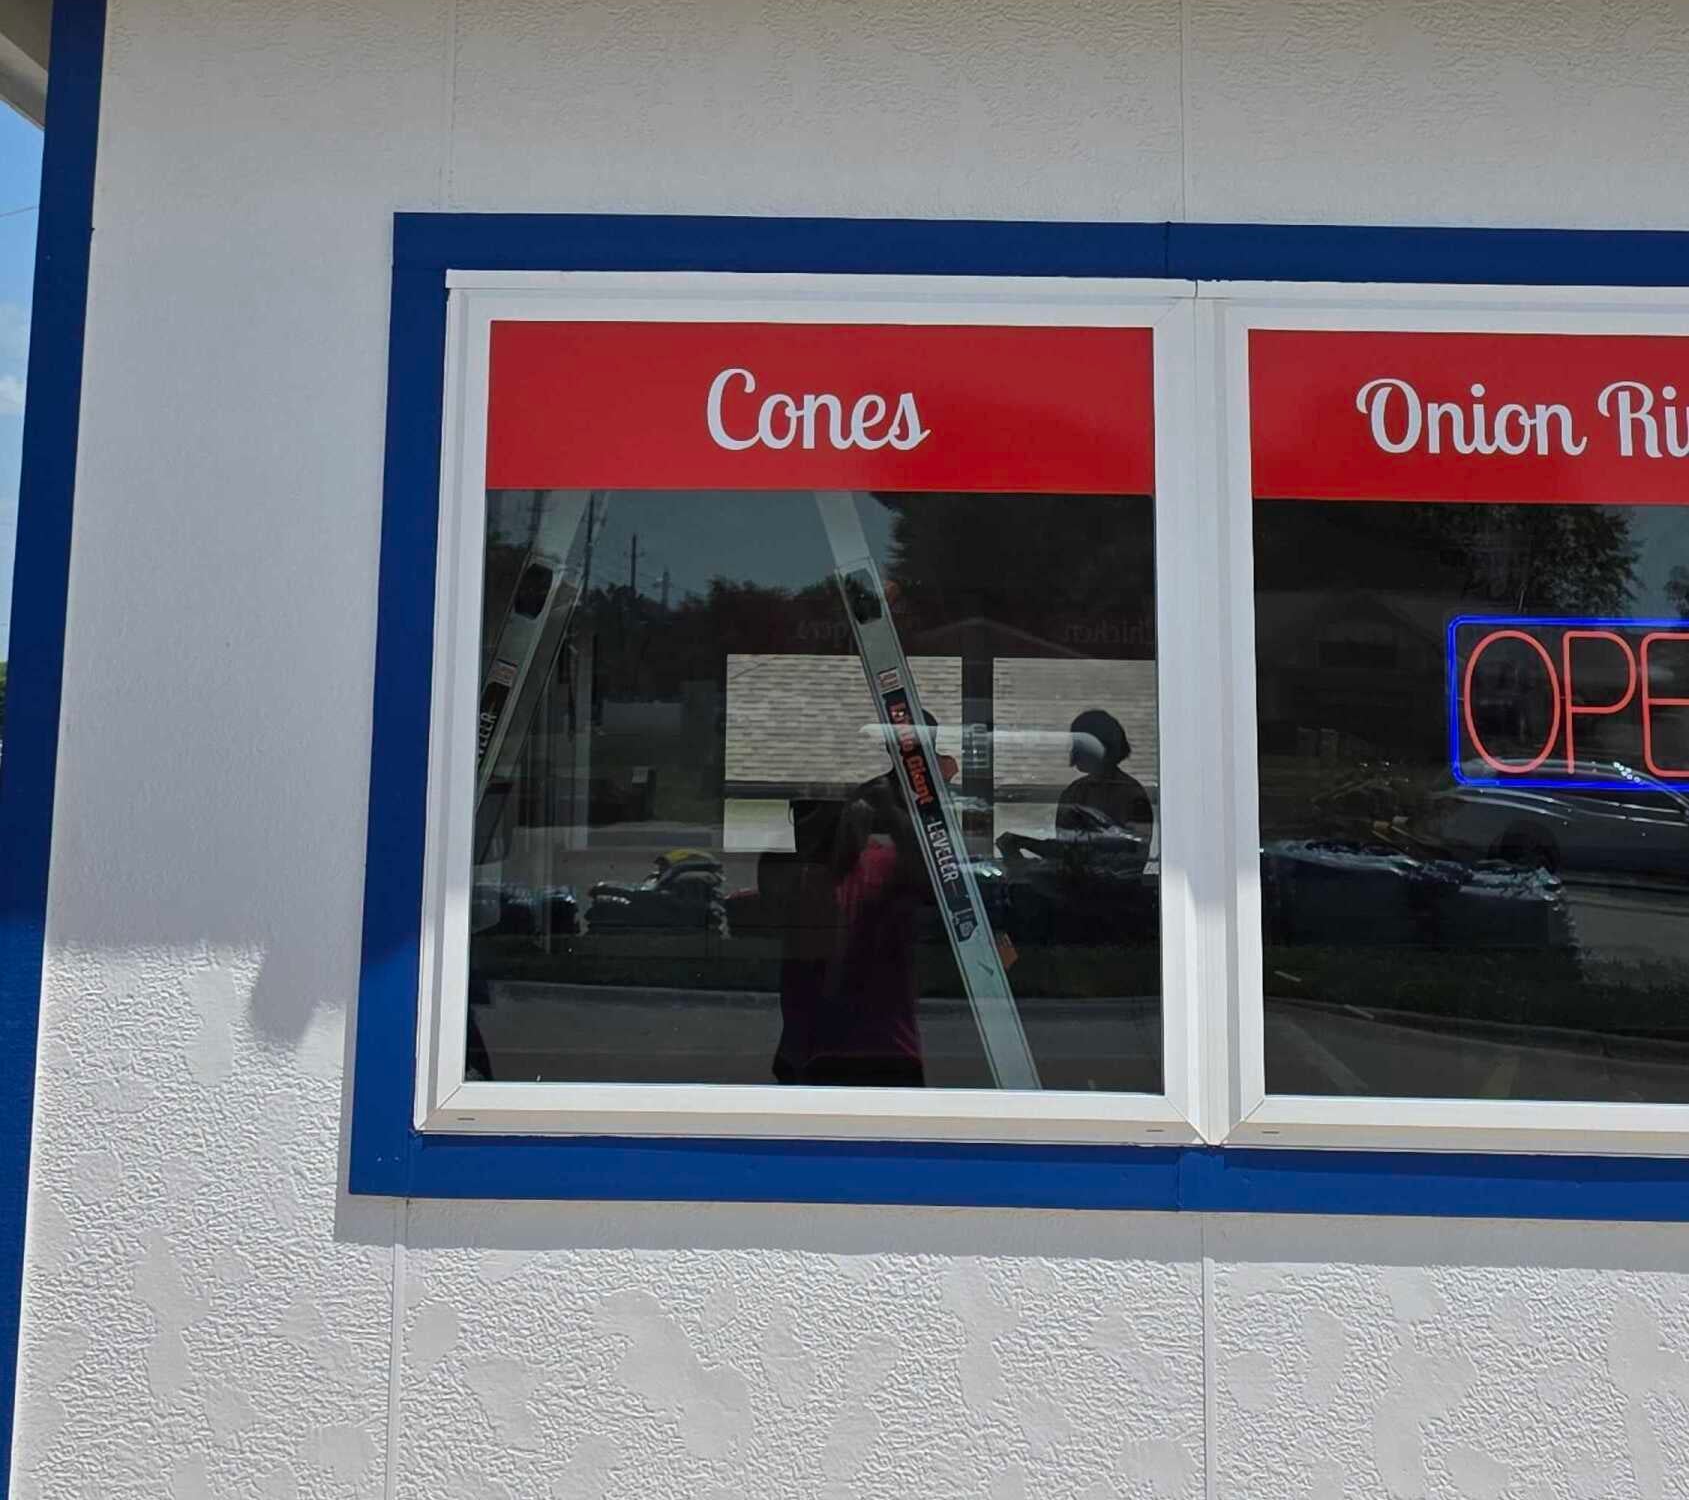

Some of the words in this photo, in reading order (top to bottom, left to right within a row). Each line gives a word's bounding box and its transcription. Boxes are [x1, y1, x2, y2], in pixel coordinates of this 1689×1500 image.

[707, 369, 931, 451] Cones
[1356, 379, 1588, 456] Onion
[1597, 381, 1689, 458] Ri
[927, 820, 959, 882] LEVELER
